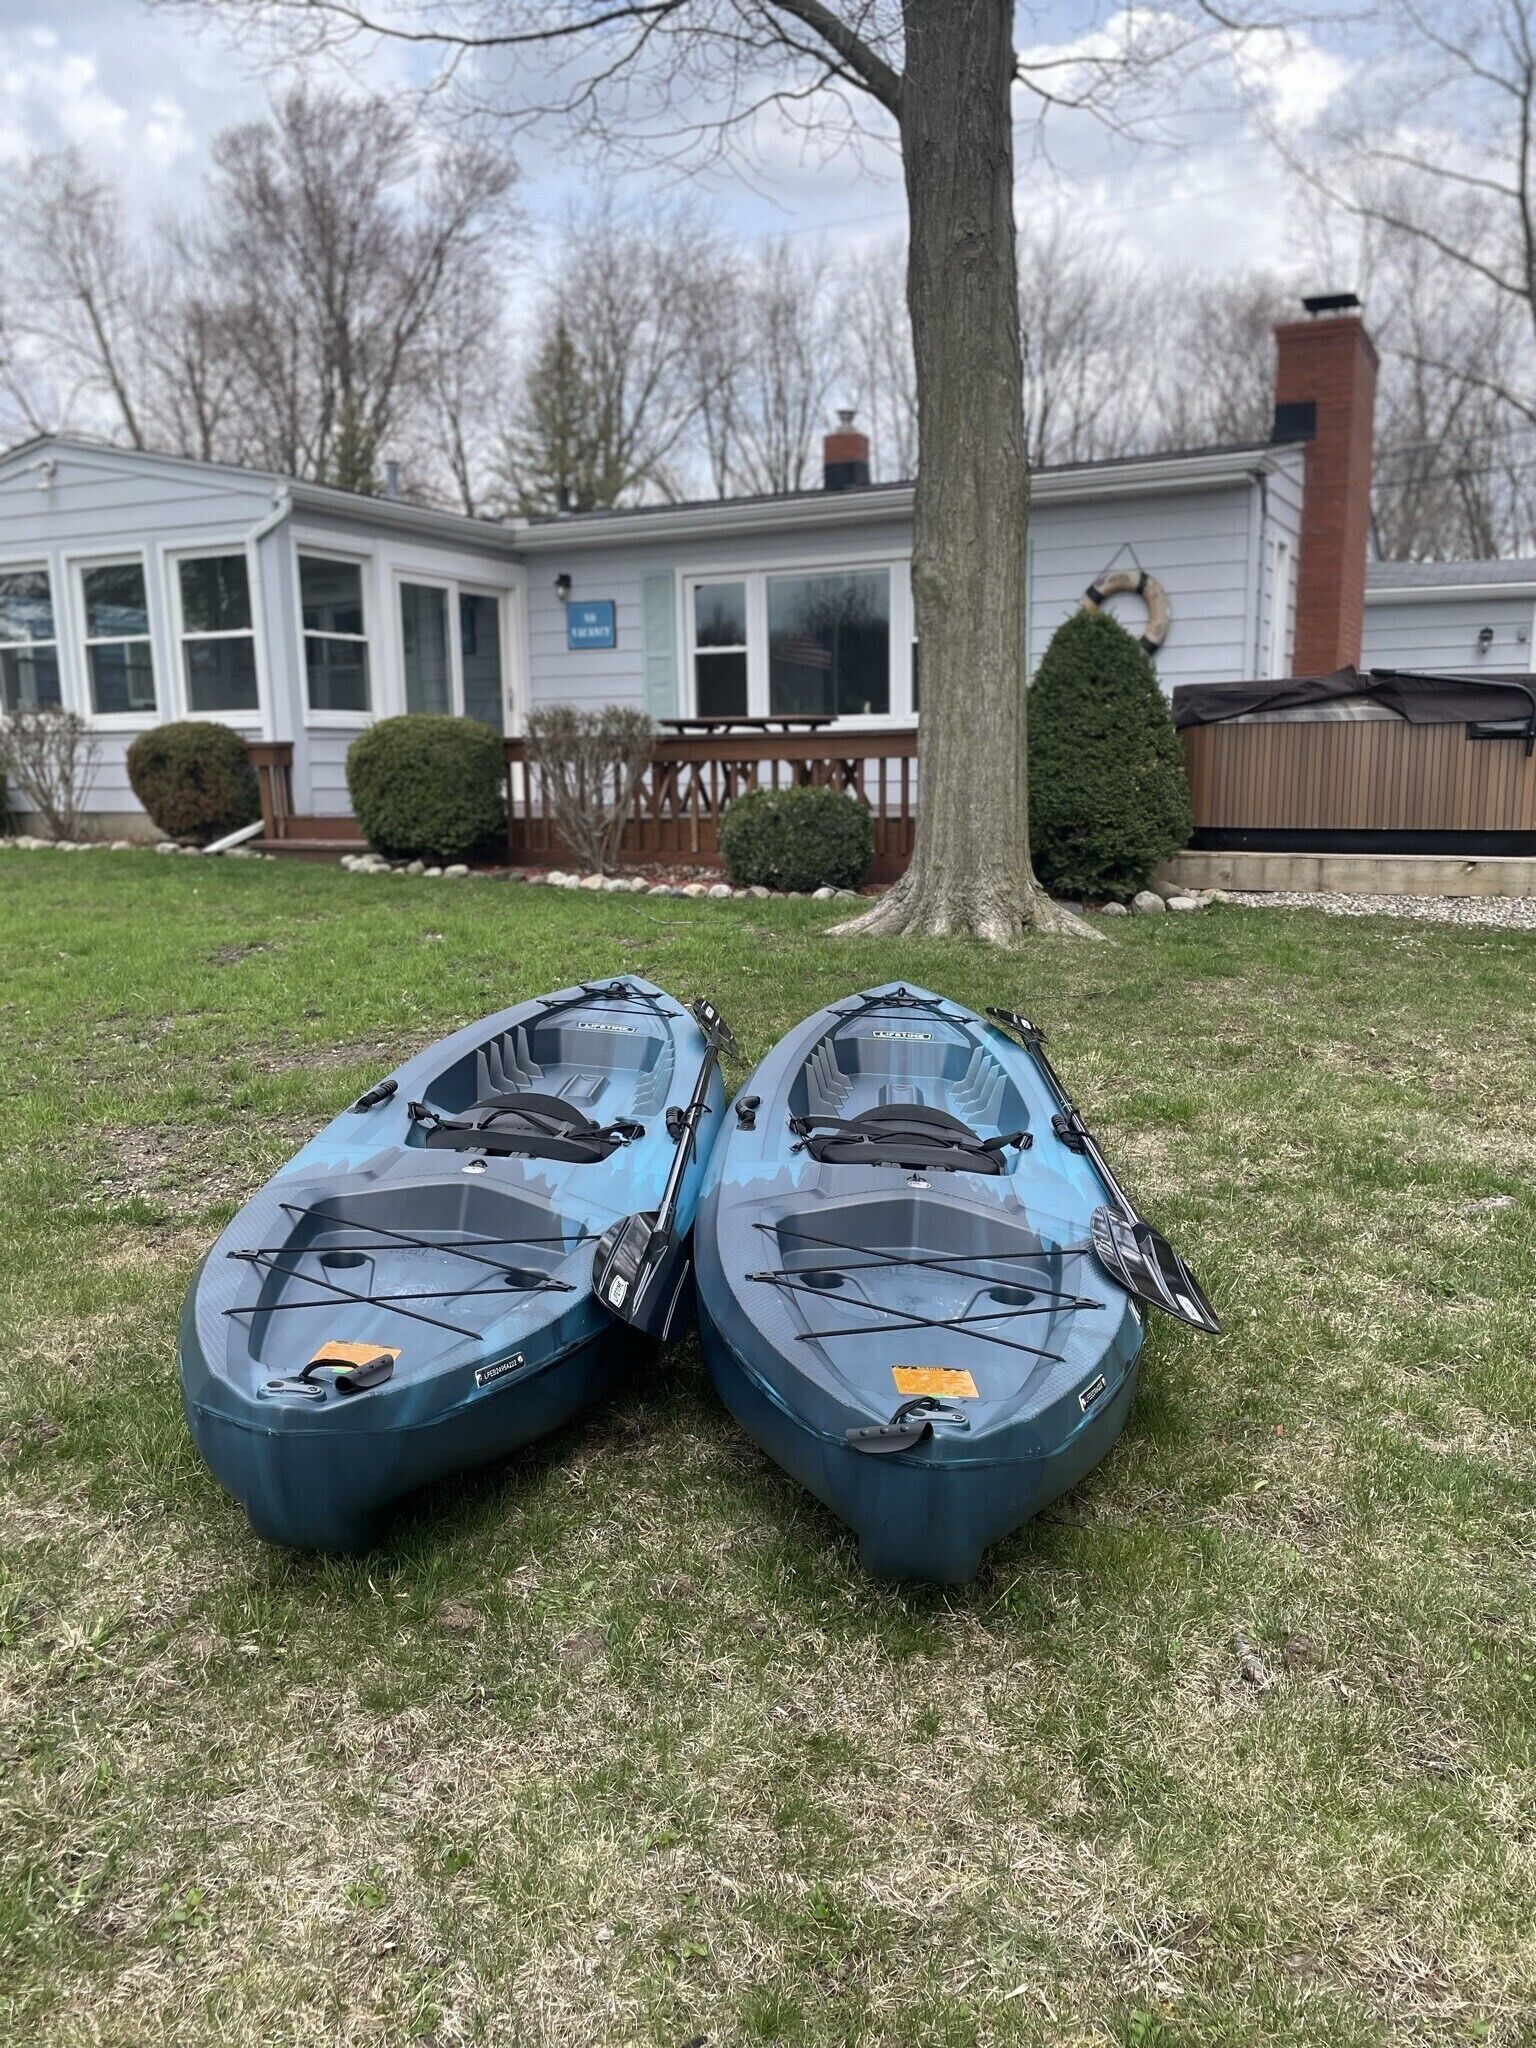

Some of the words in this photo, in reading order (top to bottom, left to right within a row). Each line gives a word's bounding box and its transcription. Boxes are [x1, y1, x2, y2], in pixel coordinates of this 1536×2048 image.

[571, 626, 610, 637] VACANCY
[584, 1023, 629, 1032] LIFETIME
[880, 1031, 925, 1039] LIFETIME
